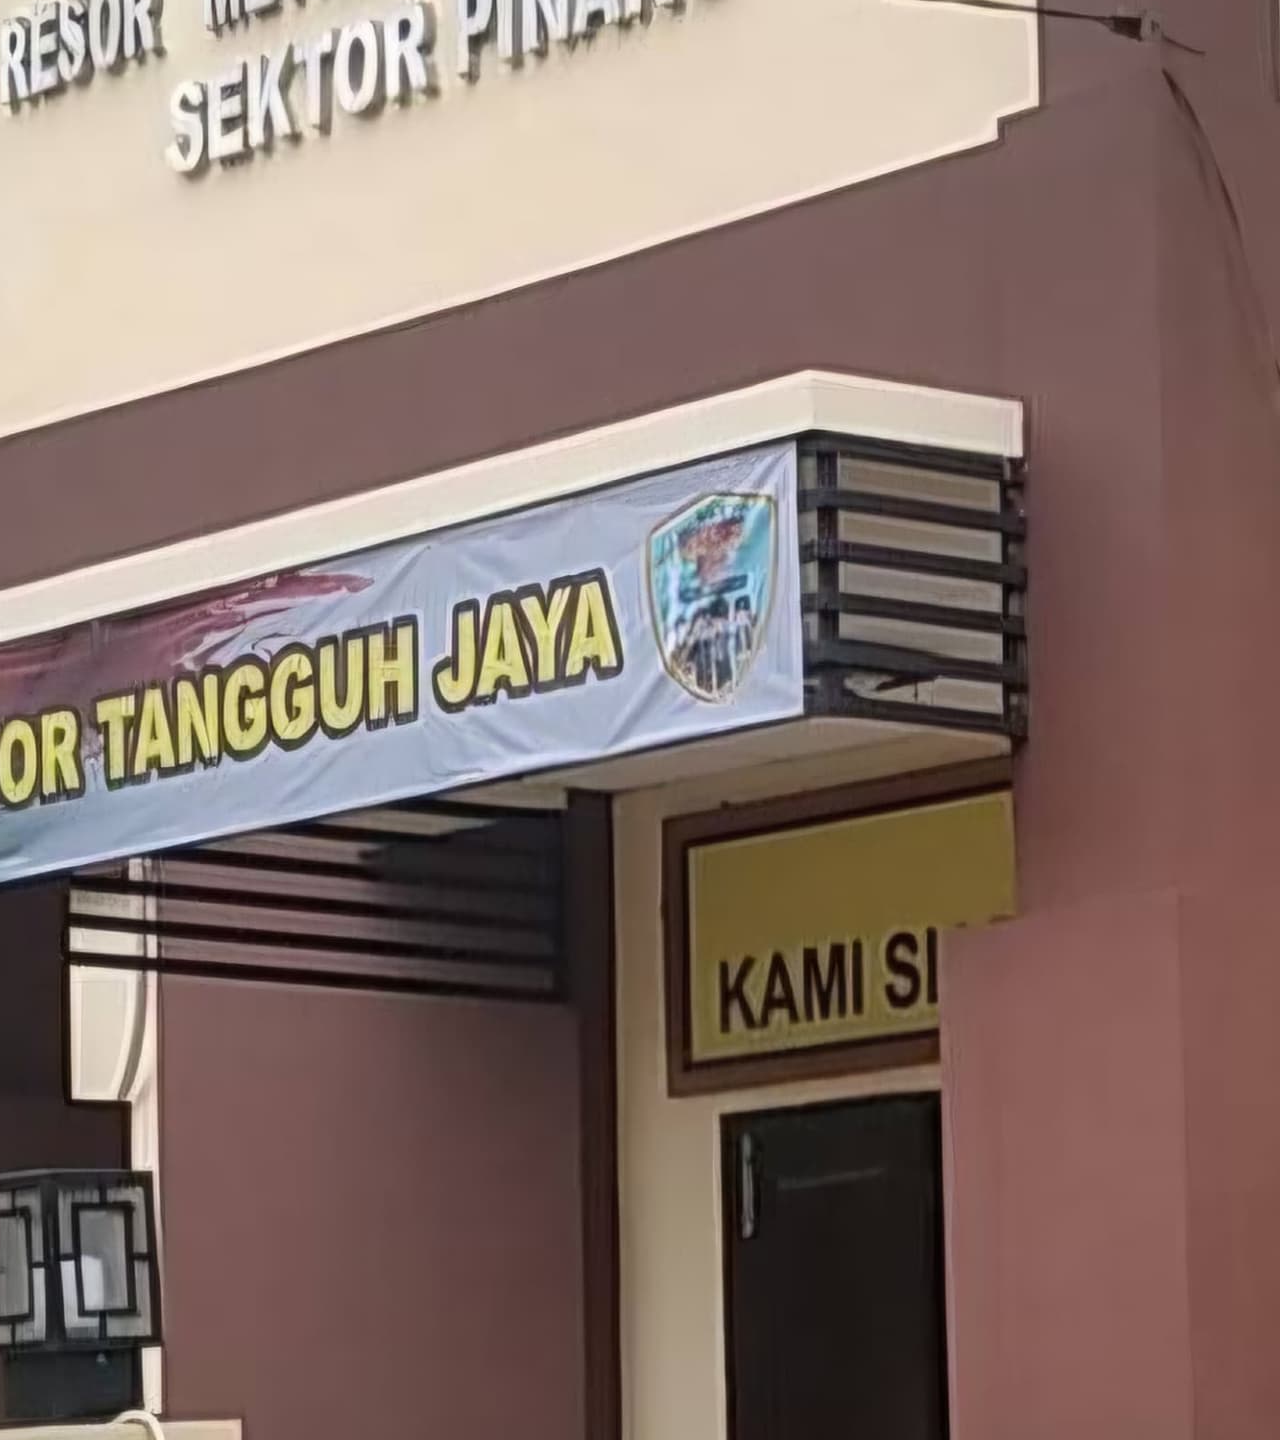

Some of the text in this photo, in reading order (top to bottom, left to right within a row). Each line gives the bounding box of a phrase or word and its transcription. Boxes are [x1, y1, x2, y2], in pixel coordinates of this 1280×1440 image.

[94, 615, 419, 788] TANGGUH
[432, 569, 622, 712] JAYA
[719, 938, 864, 1035] KAMI
